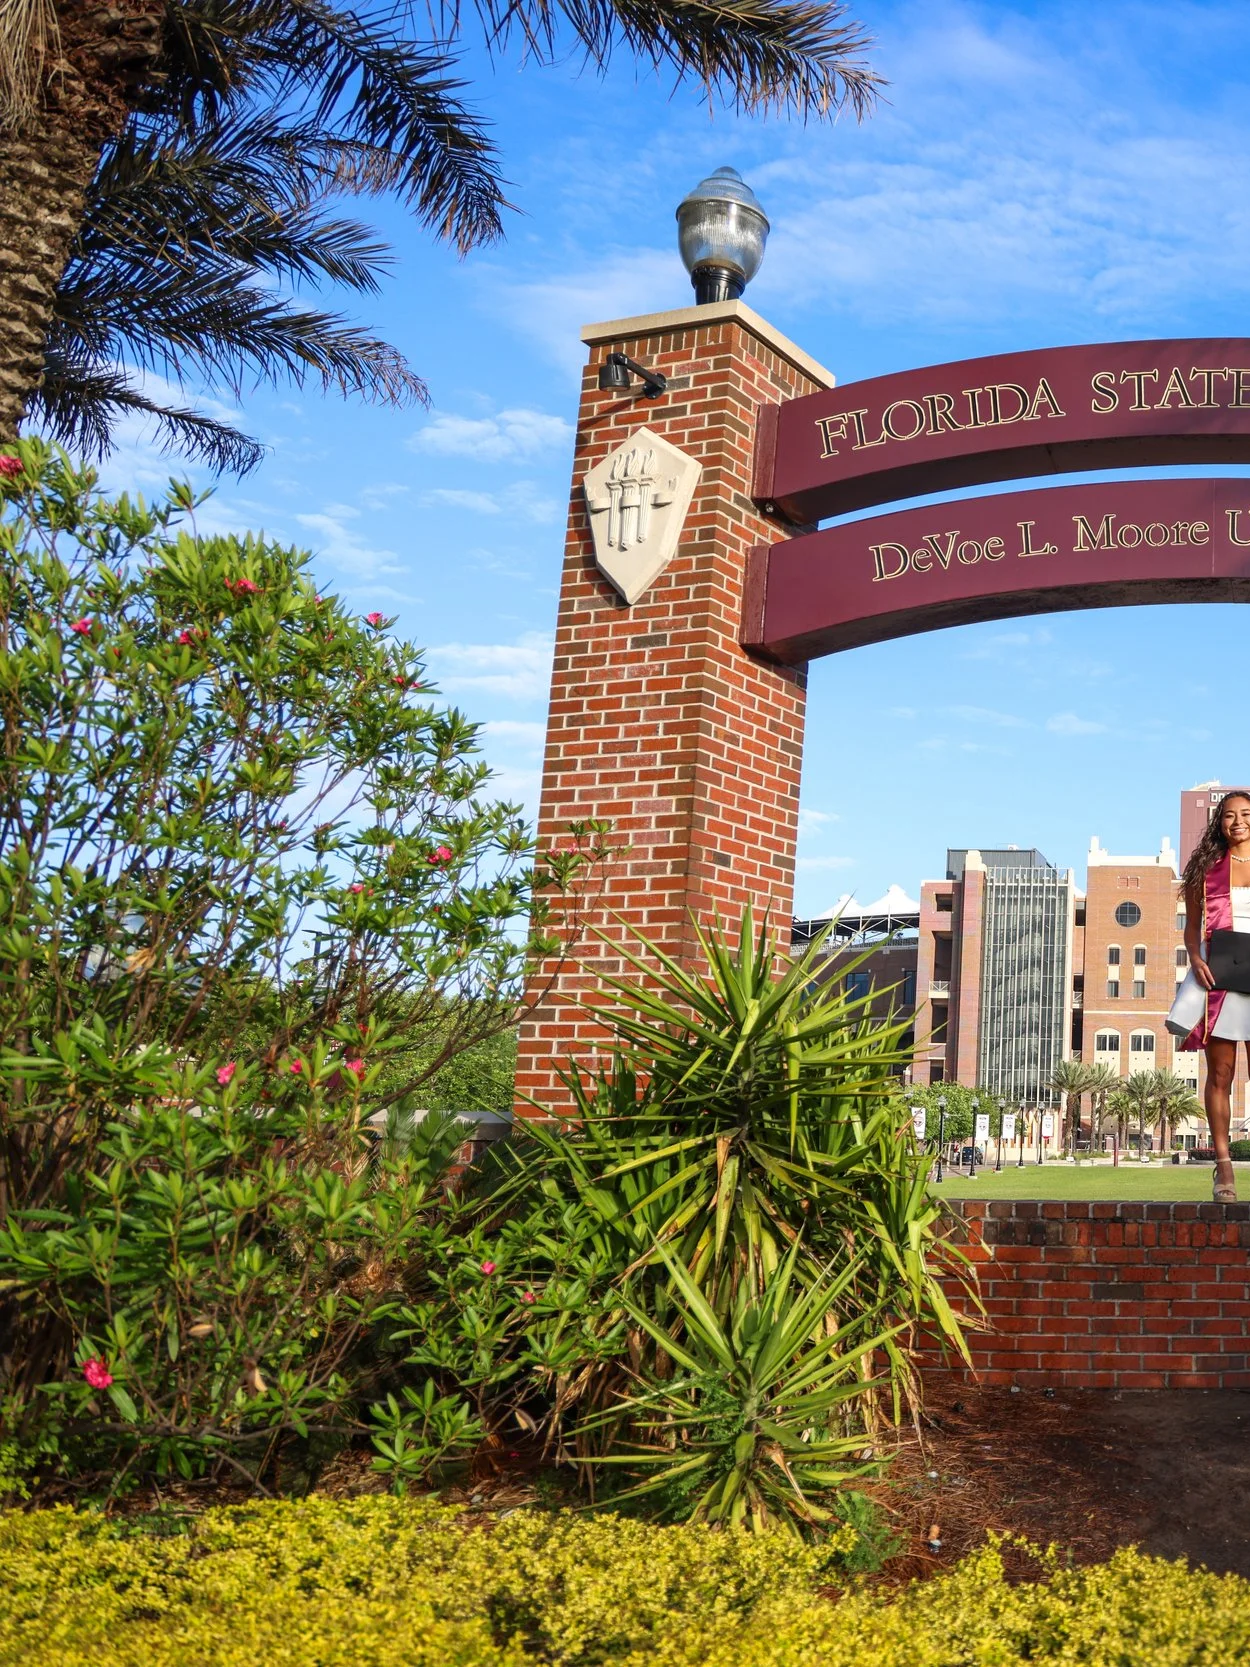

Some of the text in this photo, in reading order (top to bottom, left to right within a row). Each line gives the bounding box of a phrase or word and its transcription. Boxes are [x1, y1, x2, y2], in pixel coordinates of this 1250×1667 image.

[815, 378, 1066, 458] FLORIDA
[869, 531, 1005, 582] DeVoe
[1017, 521, 1058, 558] L.
[1072, 513, 1210, 552] Moore
